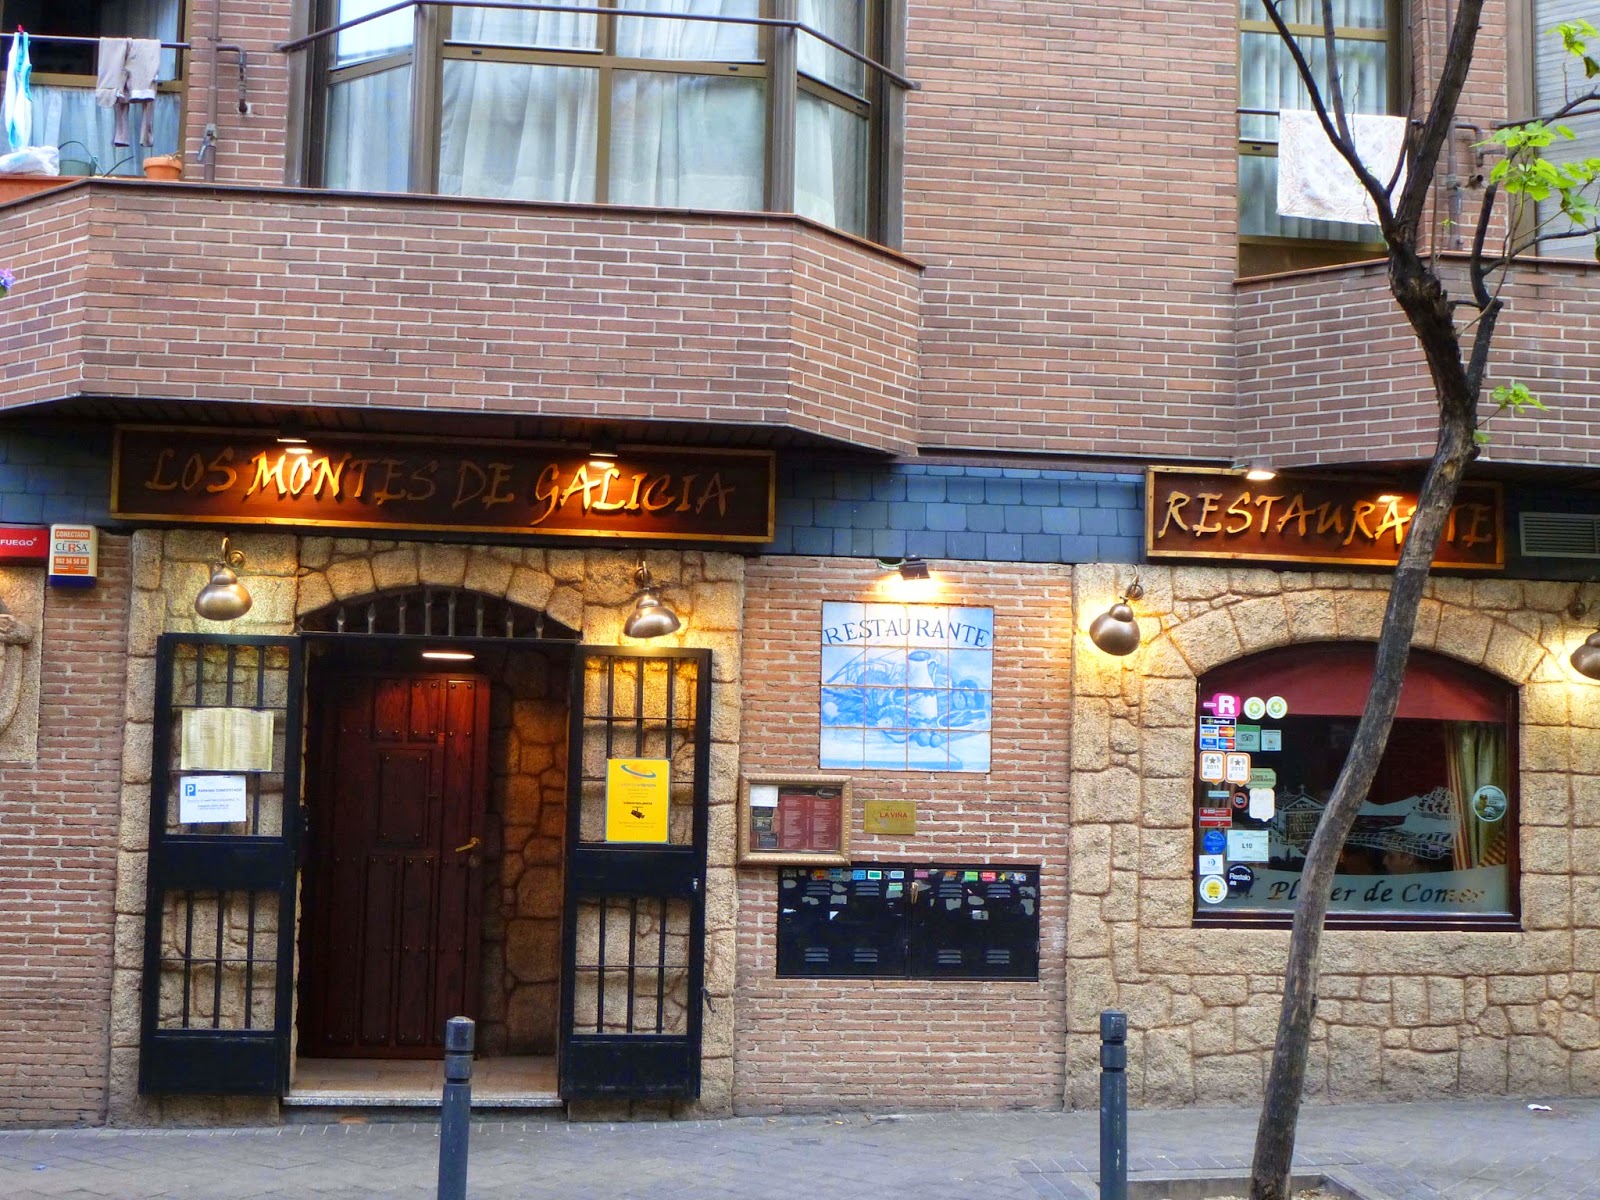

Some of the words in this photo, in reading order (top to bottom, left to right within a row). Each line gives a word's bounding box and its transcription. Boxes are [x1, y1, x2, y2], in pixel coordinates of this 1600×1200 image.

[144, 447, 238, 494] LOS
[246, 450, 438, 506] MONTES
[452, 459, 515, 512] DE
[530, 463, 737, 526] GALICIA
[1157, 491, 1494, 549] RESTAURATE
[55, 543, 88, 552] CERSA
[824, 618, 990, 648] RESTAURANTE
[1219, 695, 1236, 715] R
[1268, 880, 1356, 901] Pler
[1364, 880, 1393, 902] de
